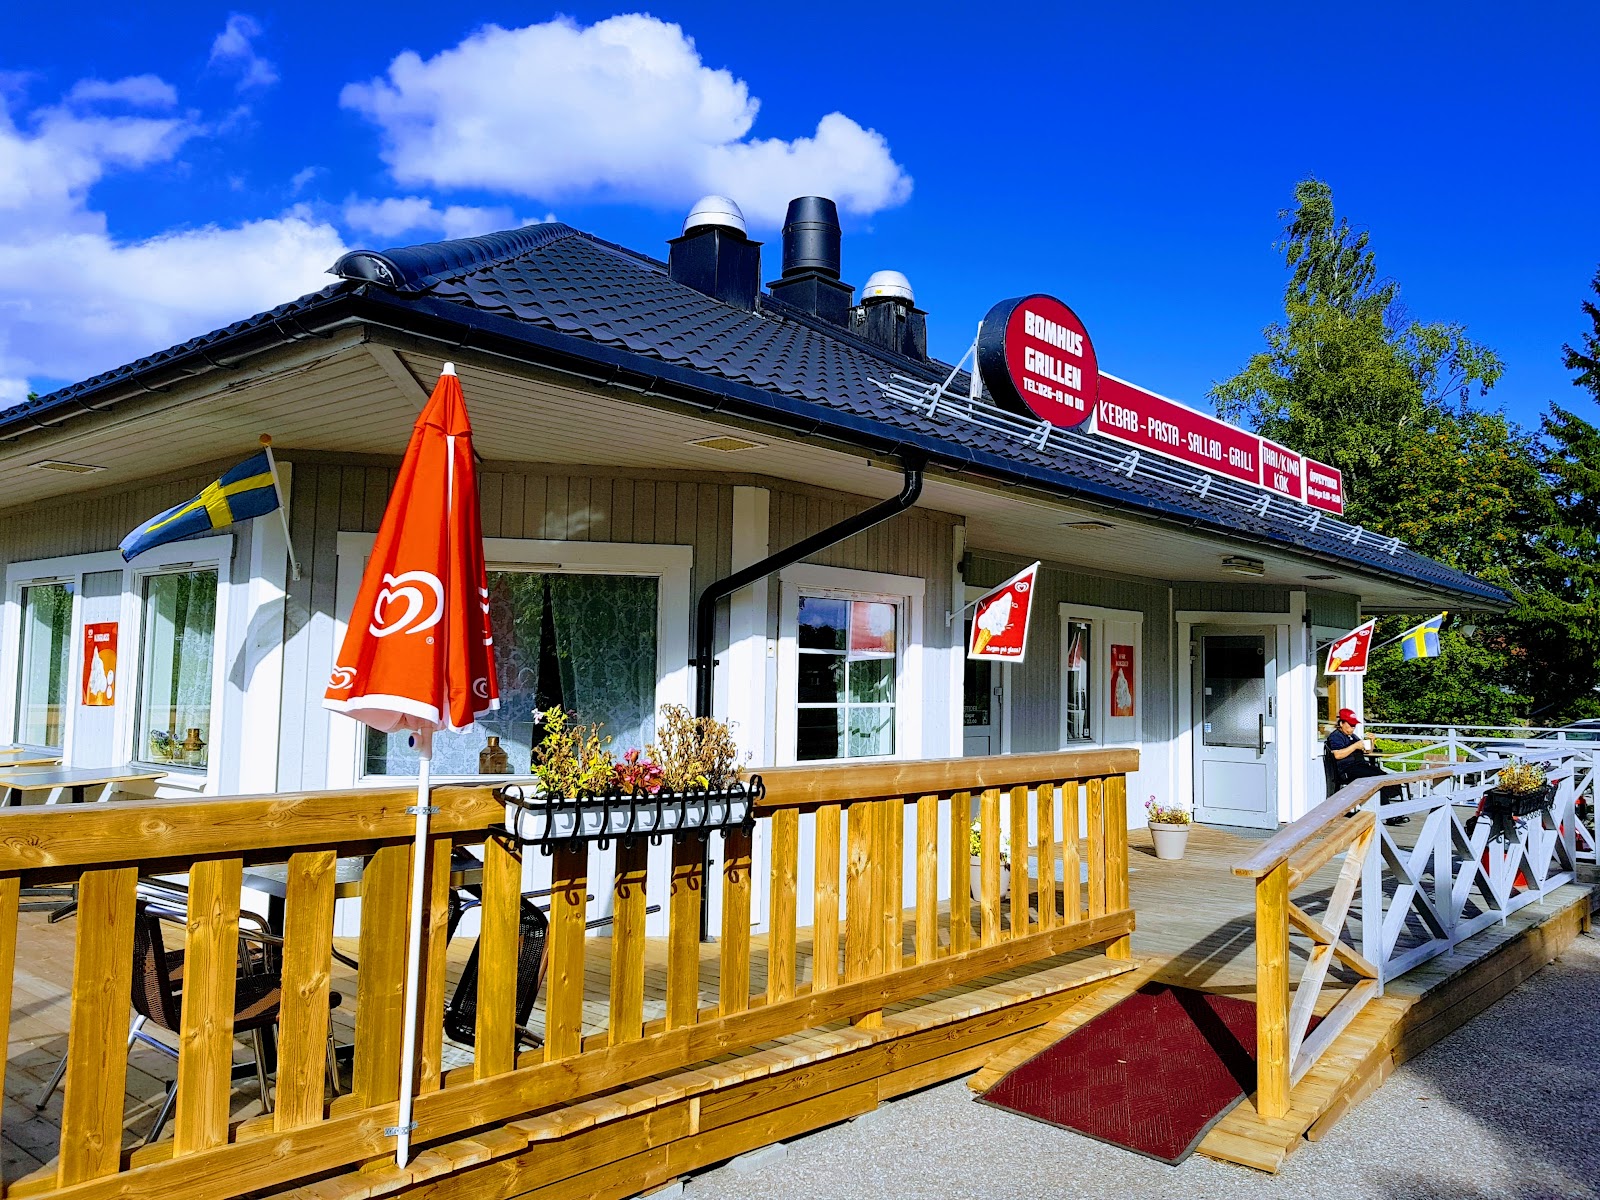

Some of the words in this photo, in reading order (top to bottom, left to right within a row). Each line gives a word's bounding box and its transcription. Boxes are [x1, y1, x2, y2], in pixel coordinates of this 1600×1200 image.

[1025, 309, 1083, 358] BOMHUS
[1024, 346, 1082, 391] GRILLEN
[1100, 399, 1138, 433] KEBAB
[1148, 416, 1180, 447] PASTA
[1188, 431, 1222, 461] SALLAD
[1229, 446, 1255, 472] GRILL
[1263, 446, 1300, 478] THAI/KINA
[1274, 470, 1290, 494] KÖK
